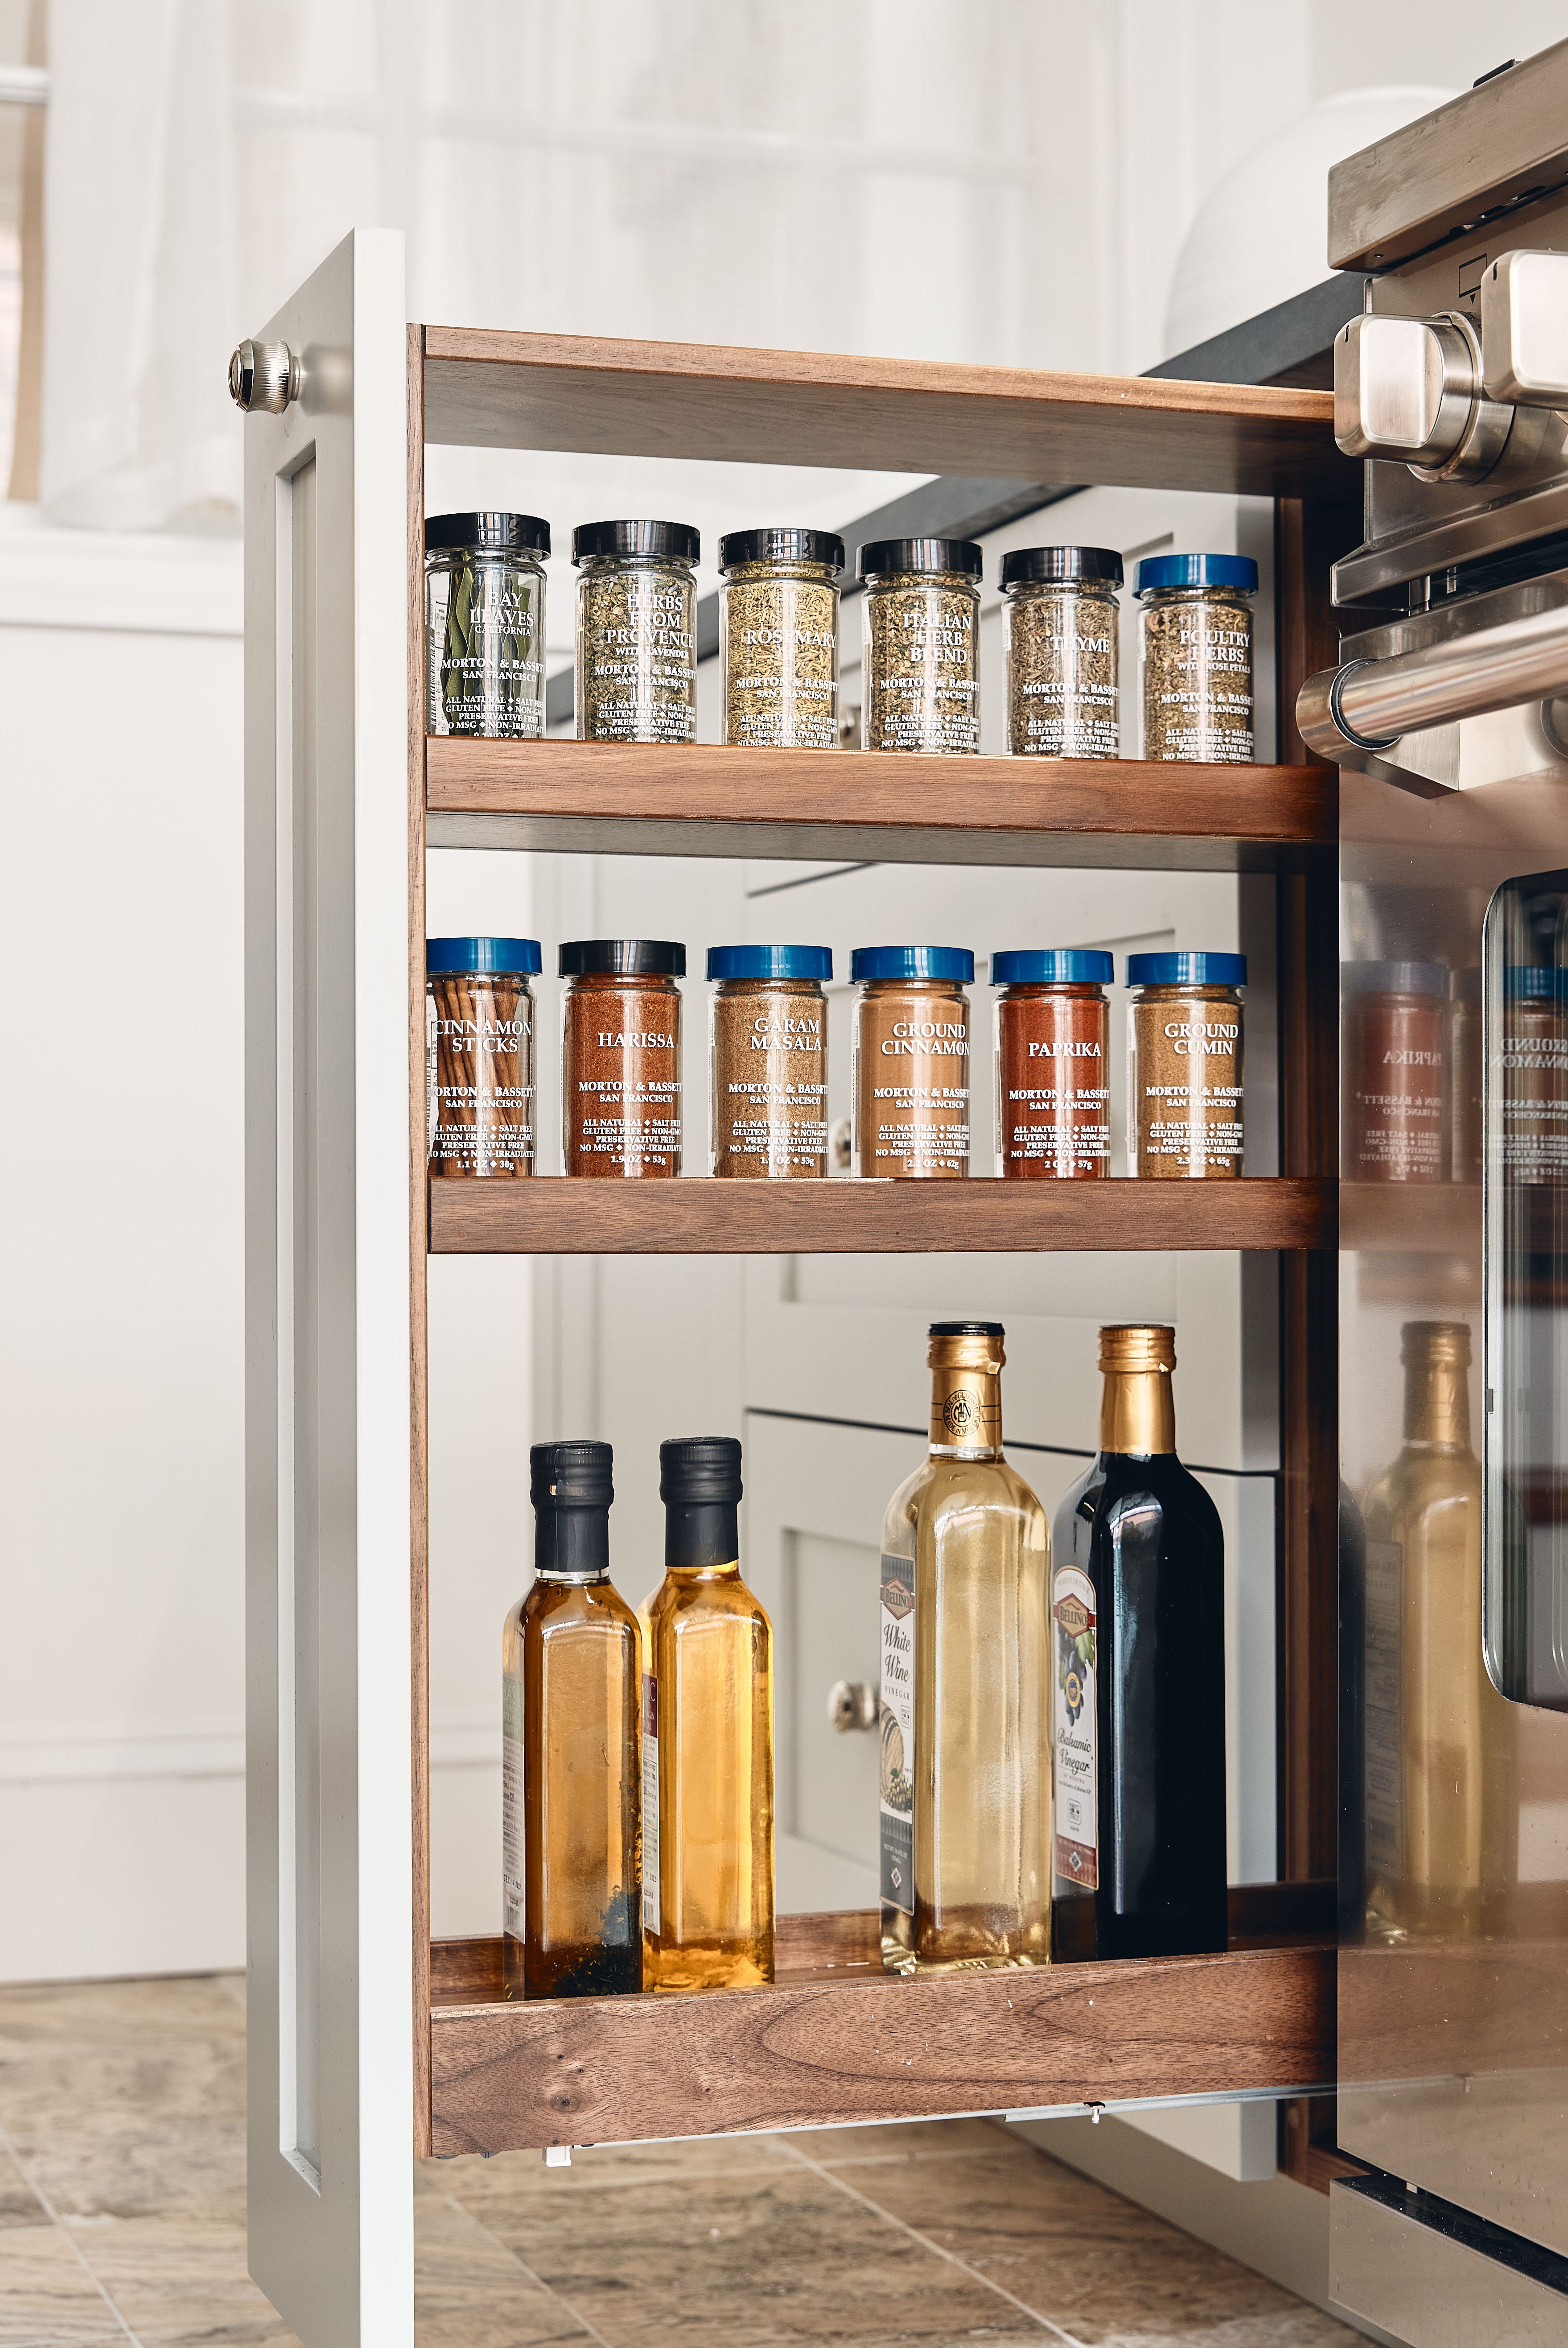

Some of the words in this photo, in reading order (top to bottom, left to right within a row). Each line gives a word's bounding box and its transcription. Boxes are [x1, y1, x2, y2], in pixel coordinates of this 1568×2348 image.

[489, 592, 522, 607] BAY
[626, 594, 683, 611] HERBS
[470, 609, 534, 627] LEAVES
[629, 611, 681, 628] FROM
[903, 614, 972, 630] ITALIAN
[475, 626, 531, 636] CALIFORNIA
[606, 629, 693, 648] PROVENCE
[746, 630, 836, 648] ROSEMARY
[916, 630, 963, 646] HERB
[1180, 630, 1250, 647] POULTRY
[910, 648, 967, 663] BLEND
[1191, 646, 1244, 662] HERBS
[441, 658, 496, 669] MORTON
[500, 659, 509, 668] &
[1230, 664, 1251, 674] PETALS
[463, 671, 483, 679] SAN
[486, 672, 537, 682] FRANCISCO
[652, 664, 661, 674] &
[665, 665, 696, 680] BASSETT
[616, 677, 636, 685] SAN
[737, 677, 788, 689] MORTON
[793, 678, 802, 687] &
[805, 679, 839, 692] BASSETT
[881, 677, 933, 689] MORTON
[936, 678, 947, 687] &
[901, 690, 921, 698] SAN
[1079, 684, 1088, 693] &
[1044, 696, 1065, 704] SAN
[1161, 693, 1214, 704] MORTON
[1217, 693, 1226, 702] &
[1182, 705, 1201, 713] SAN
[1204, 705, 1249, 715] FRANCISCO
[458, 713, 522, 721] PRESERVATIVE
[524, 714, 539, 724] FREE
[612, 719, 674, 727] PRESERVATIVE
[675, 720, 690, 729] FREE
[433, 1020, 531, 1035] CINNAMON
[754, 1018, 820, 1033] GARAM
[893, 1023, 966, 1038] GROUND
[1165, 1023, 1238, 1038] GROUND
[452, 1038, 518, 1052] STICKS
[598, 1033, 675, 1048] HARISSA
[750, 1036, 822, 1051] MASALA
[881, 1040, 970, 1056] CINNAMON
[1029, 1042, 1101, 1056] PAPRIKA
[1174, 1040, 1233, 1055] CUMIN
[482, 1087, 492, 1096] &
[495, 1087, 534, 1097] BASSETT
[579, 1081, 631, 1091] MORTON
[636, 1081, 646, 1091] &
[648, 1081, 681, 1092] BASSETT
[728, 1083, 782, 1093] MORTON
[786, 1084, 795, 1092] &
[798, 1084, 828, 1094] BASSETT
[874, 1088, 928, 1098] MORTON
[931, 1088, 940, 1097] &
[1146, 1086, 1198, 1096] MORTON
[1201, 1087, 1210, 1096] &
[623, 1094, 673, 1102] FRANCISCO
[1009, 1089, 1060, 1099] MORTON
[1064, 1090, 1074, 1099] &
[1077, 1089, 1109, 1099] BASSETT
[445, 1100, 465, 1108] SAN
[469, 1100, 522, 1108] FRANCISCO
[772, 1097, 820, 1105] FRANCISCO
[918, 1100, 964, 1108] FRANCISCO
[1166, 1098, 1186, 1106] SAN
[1189, 1099, 1236, 1107] FRANCISCO
[499, 1160, 514, 1170] 30g
[610, 1155, 623, 1163] 1.9
[653, 1155, 667, 1165] 53g
[801, 1156, 815, 1166] 53g
[947, 1160, 959, 1169] 62g
[1078, 1160, 1092, 1170] 57g
[1217, 1157, 1230, 1167] 65g
[945, 1400, 953, 1413] SEAL
[945, 1415, 956, 1431] MADE
[886, 1589, 909, 1608] BELLINO
[1060, 1605, 1087, 1626] BELLINO
[884, 1624, 911, 1652] White
[885, 1654, 910, 1682] Wine
[885, 1685, 910, 1700] VINEGAR
[1058, 1727, 1091, 1752] Balsamic
[1059, 1748, 1090, 1775] Vinegar
